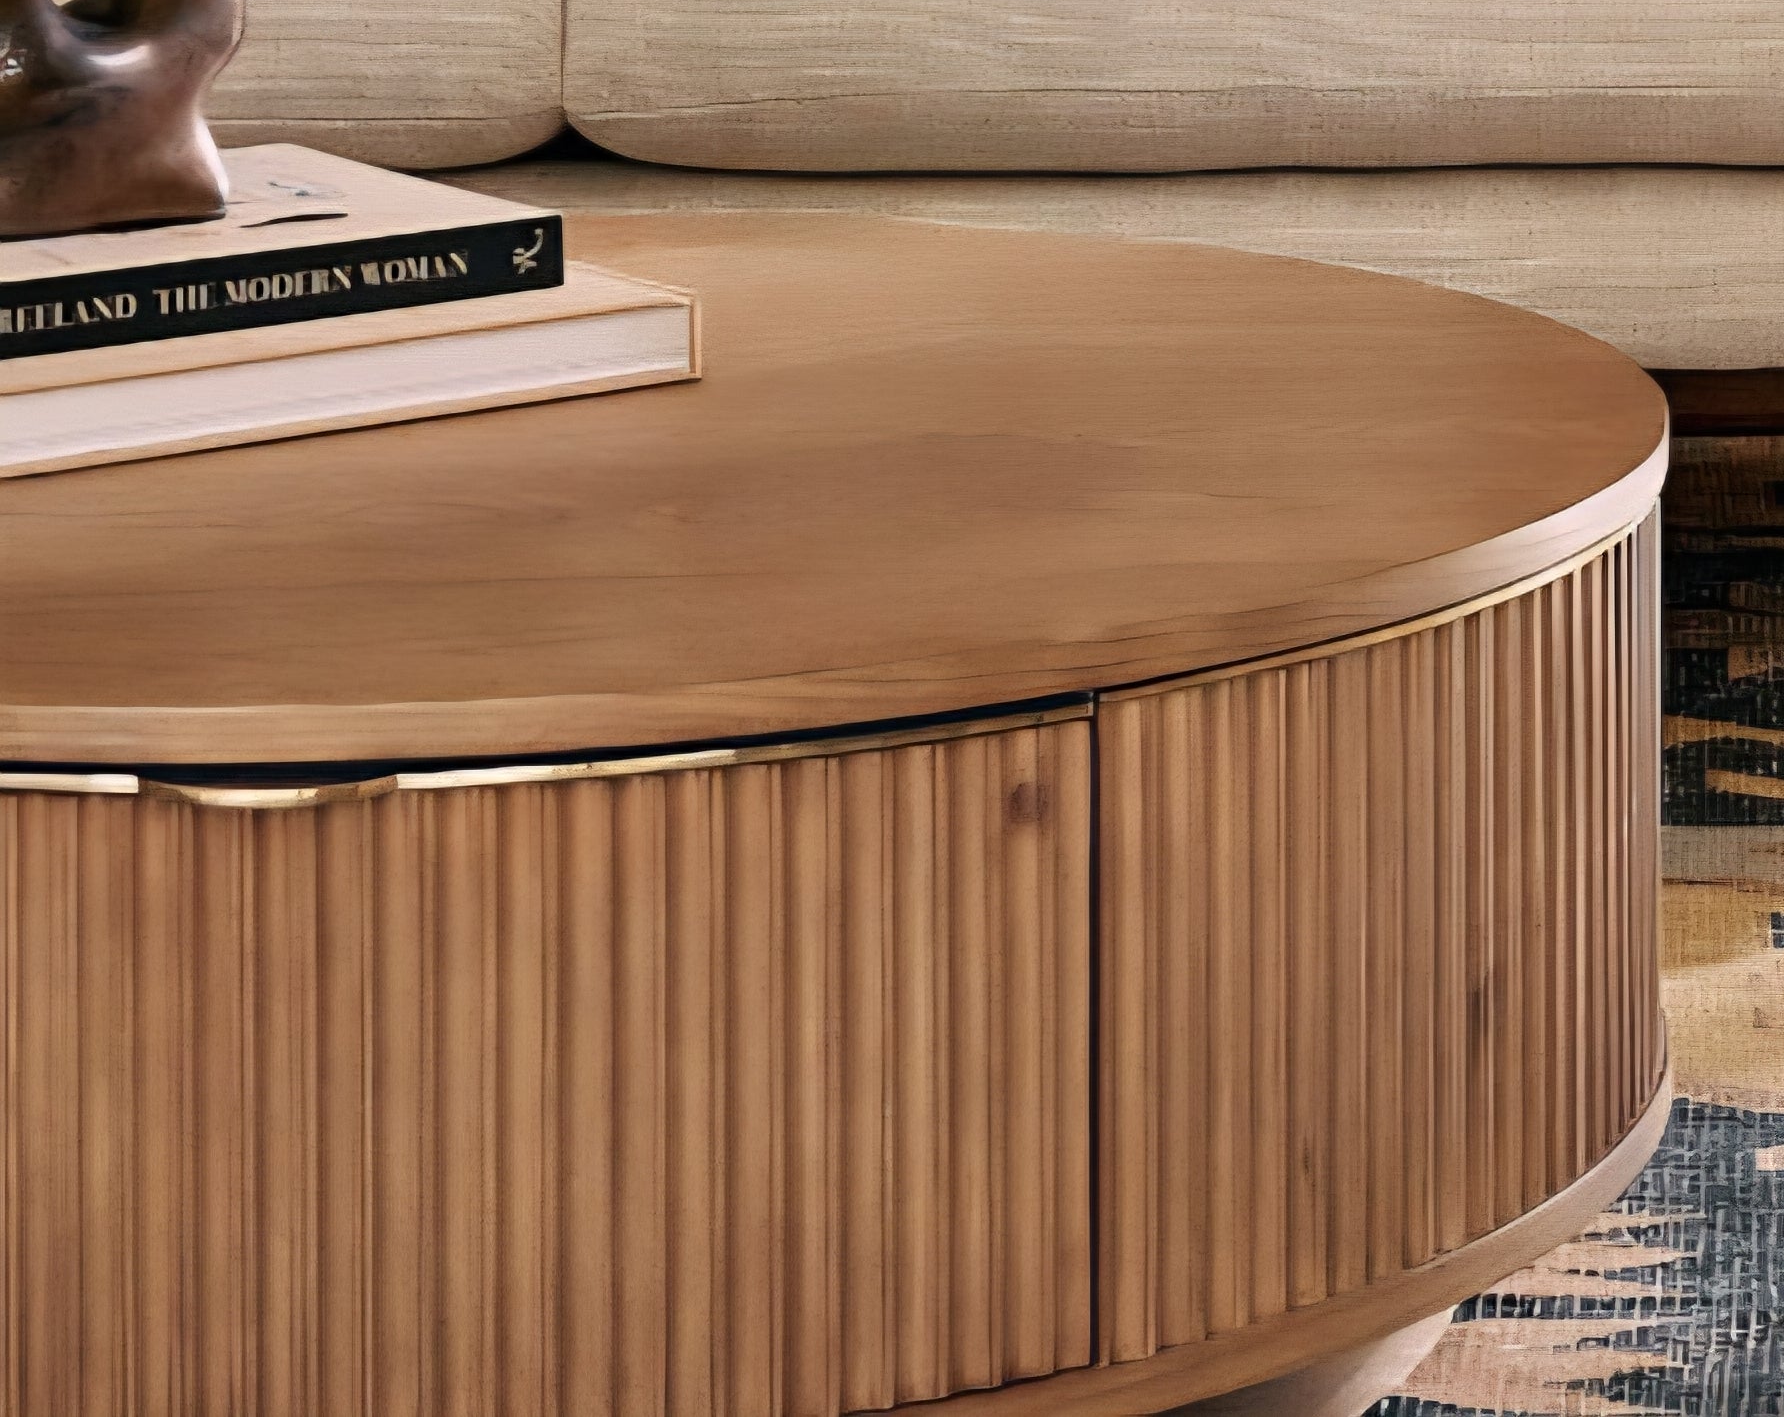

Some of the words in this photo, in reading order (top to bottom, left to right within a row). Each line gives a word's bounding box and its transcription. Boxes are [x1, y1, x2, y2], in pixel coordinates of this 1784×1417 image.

[152, 281, 217, 315] THE
[225, 266, 352, 305] MODERN
[360, 250, 469, 286] WOMAN
